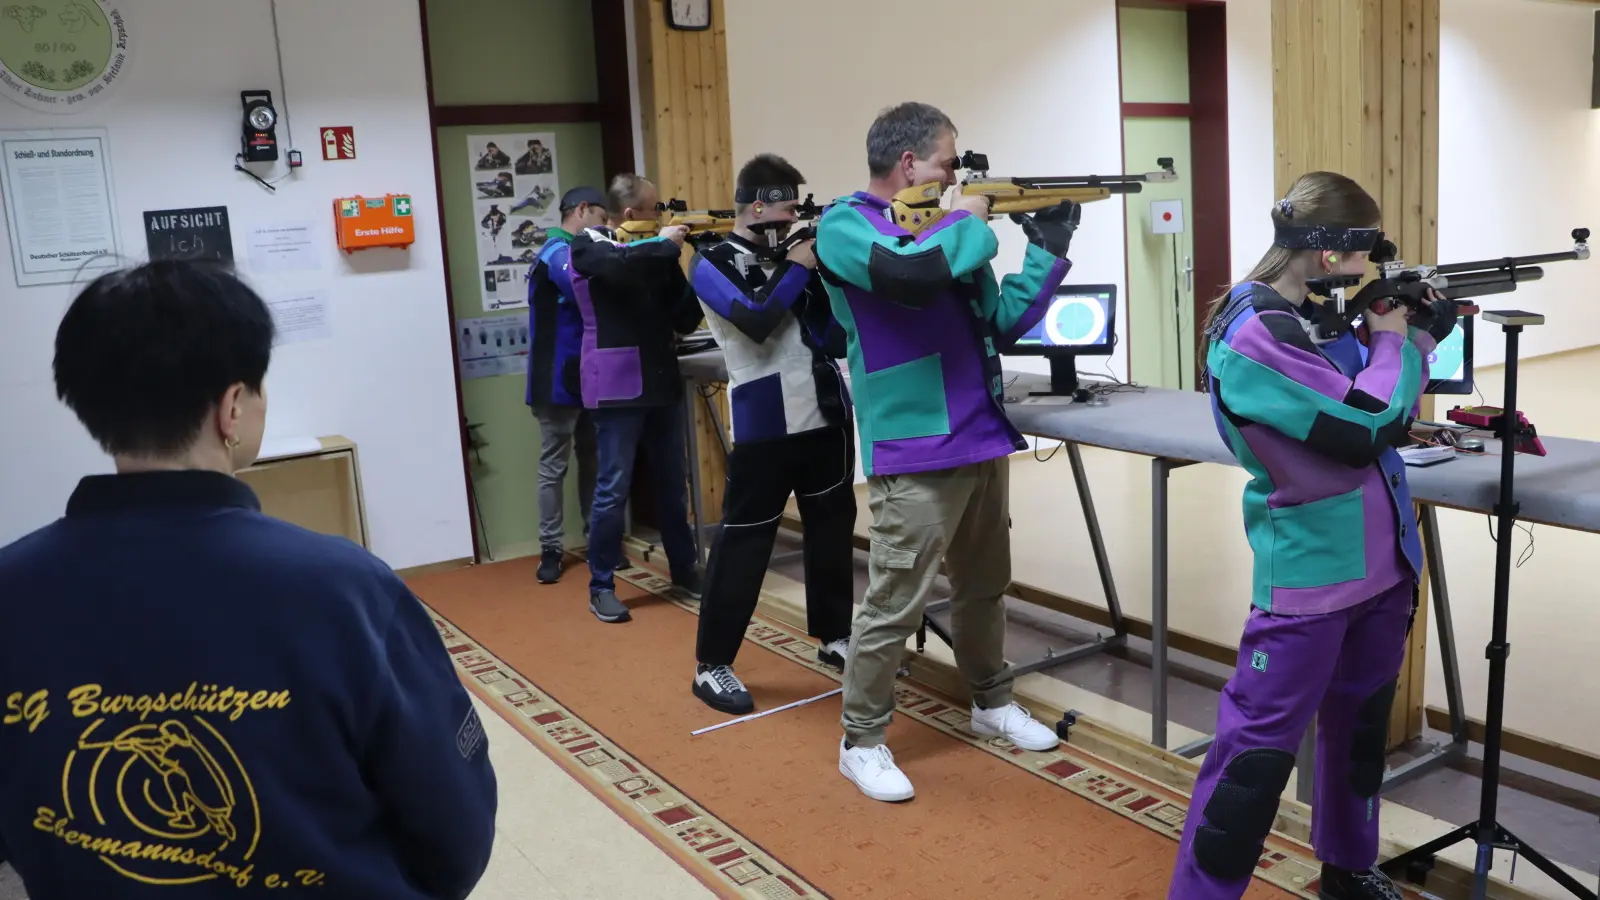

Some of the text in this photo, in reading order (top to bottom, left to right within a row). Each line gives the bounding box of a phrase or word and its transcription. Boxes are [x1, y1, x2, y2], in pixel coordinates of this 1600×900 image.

[14, 148, 94, 160] Schieß- und Standordnung
[151, 212, 222, 231] AUFSICHT
[355, 226, 404, 237] Erste Hilfe
[30, 252, 58, 260] Deutscher
[58, 249, 99, 258] Schützenbund
[4, 681, 291, 733] SG Burgschützen
[33, 806, 254, 888] Ebermannsdorf
